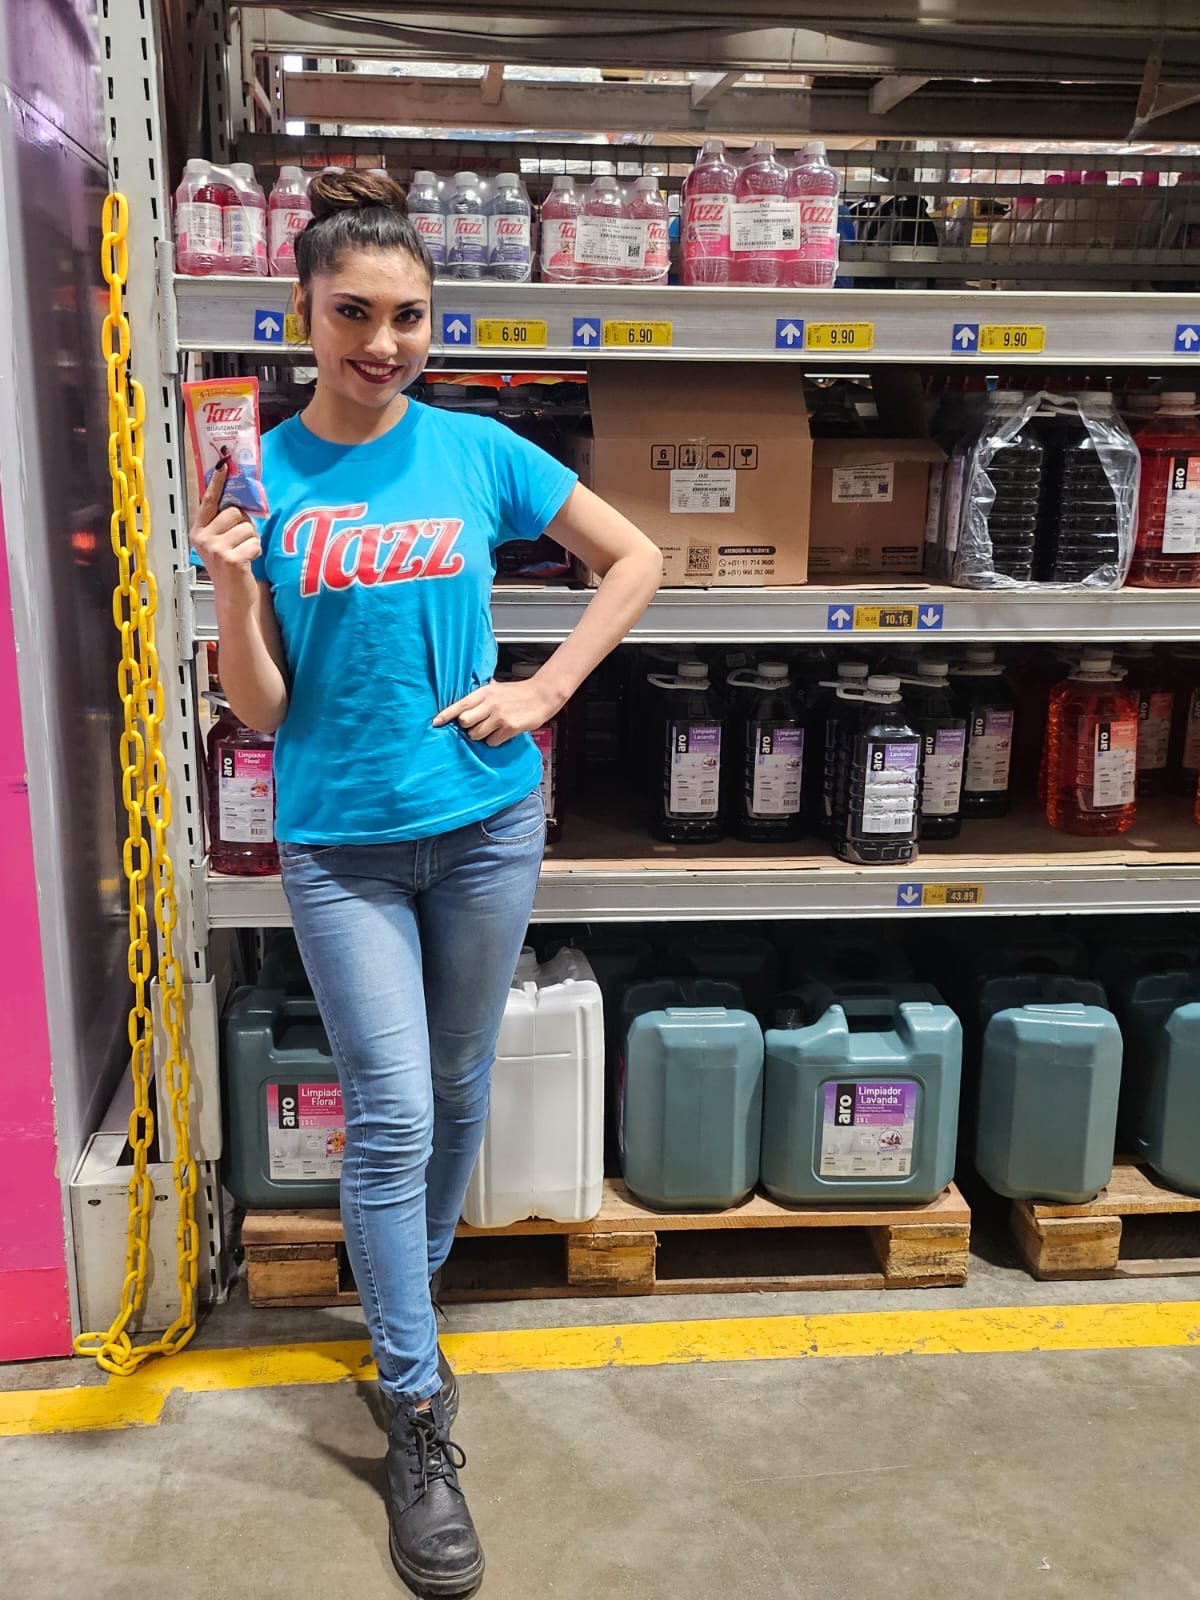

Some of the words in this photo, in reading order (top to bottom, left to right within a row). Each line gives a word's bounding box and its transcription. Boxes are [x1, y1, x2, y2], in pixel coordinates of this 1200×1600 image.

[687, 198, 725, 222] Tazz
[415, 216, 443, 234] Tazz
[453, 217, 482, 235] Tazz
[495, 217, 524, 235] Tazz
[502, 326, 527, 342] 6.90
[628, 328, 653, 343] 6.90
[831, 329, 855, 344] 9.90
[1003, 332, 1027, 346] 9.90
[203, 402, 243, 423] Tazz
[660, 449, 667, 459] 6
[1174, 467, 1186, 489] aro
[282, 502, 465, 598] Tazz
[885, 614, 909, 624] 10.16
[974, 718, 984, 736] aro
[678, 734, 687, 752] aro
[762, 736, 771, 754] aro
[925, 736, 934, 754] aro
[1100, 732, 1109, 750] aro
[223, 757, 233, 777] aro
[873, 751, 883, 770] aro
[301, 1087, 342, 1098] Limpiado
[858, 1086, 902, 1097] Limpiador
[861, 1095, 898, 1104] Lavanda
[311, 1097, 336, 1106] Floral
[838, 1094, 852, 1124] aro
[282, 1096, 296, 1127] aro
